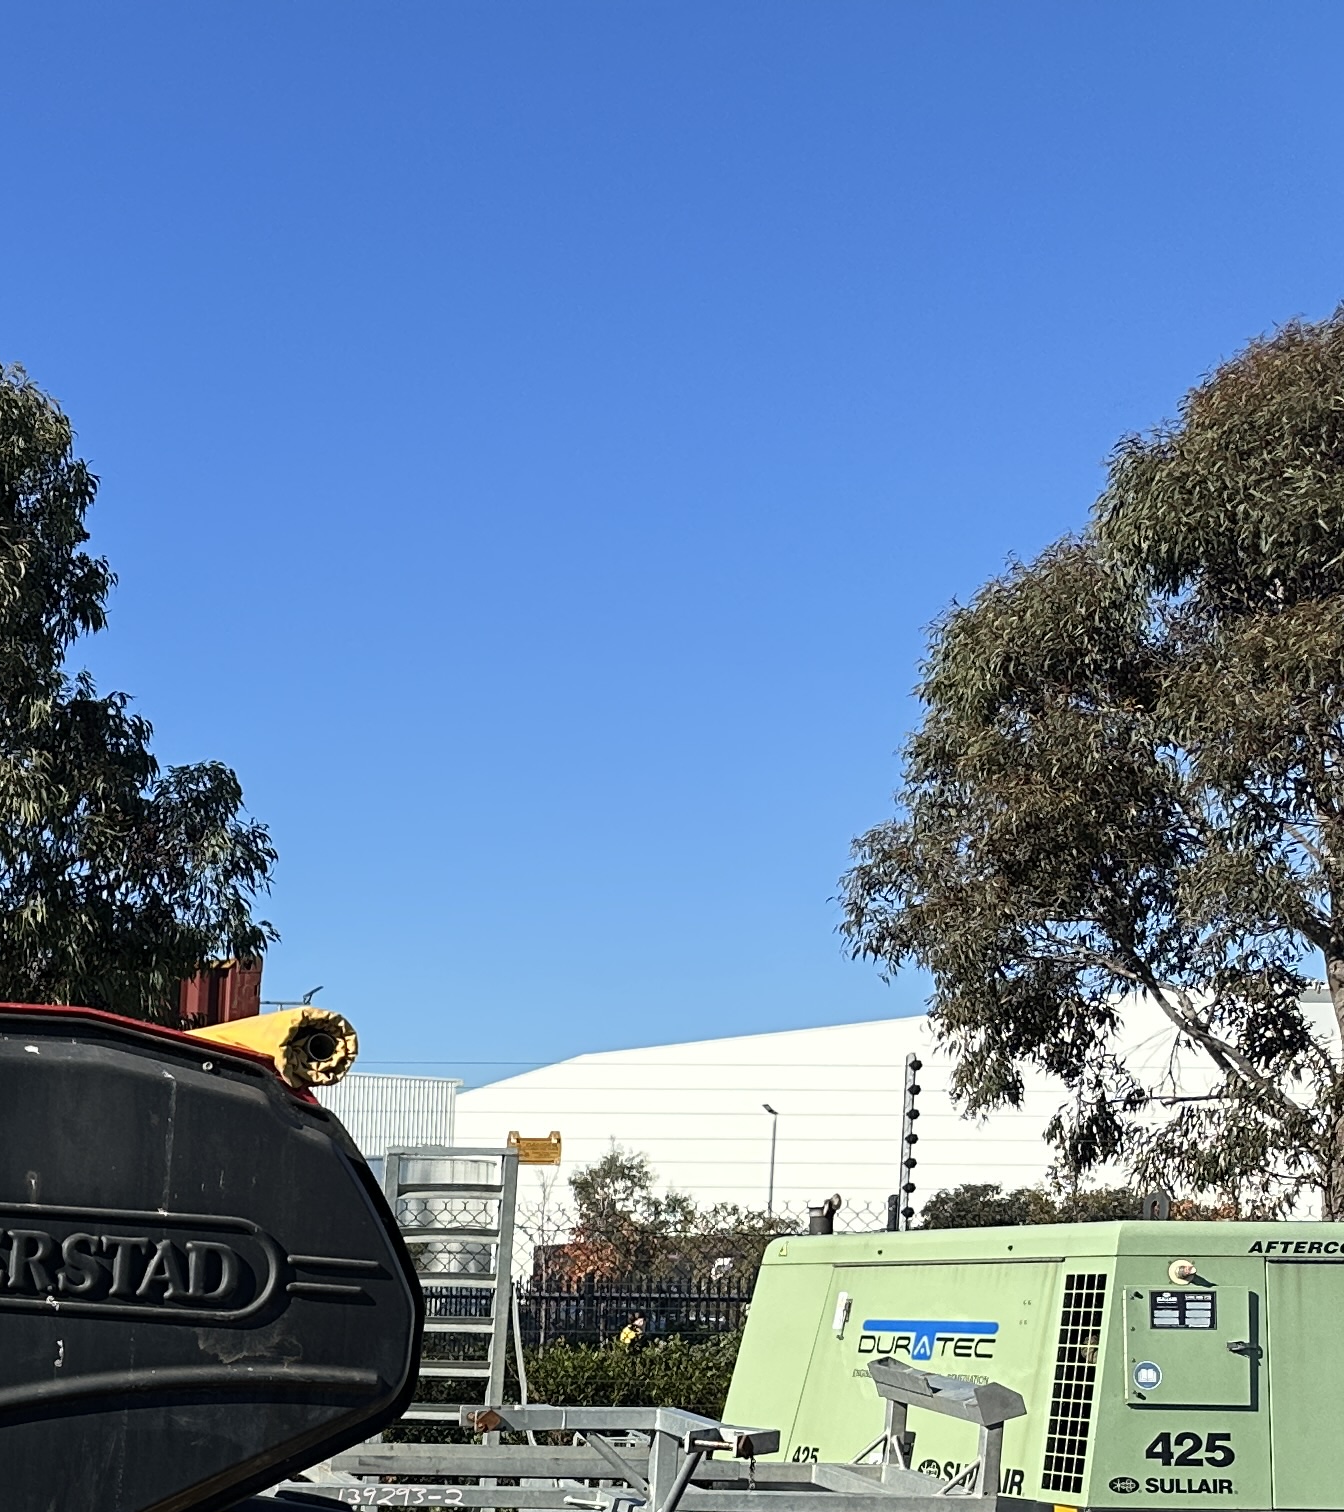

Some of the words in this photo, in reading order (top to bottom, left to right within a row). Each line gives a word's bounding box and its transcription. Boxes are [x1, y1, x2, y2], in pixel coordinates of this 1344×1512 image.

[857, 1333, 997, 1360] DURATEC
[791, 1446, 820, 1464] 425
[1145, 1431, 1236, 1468] 425
[1145, 1477, 1234, 1495] SULLAIR
[338, 1487, 465, 1507] 139293-2
